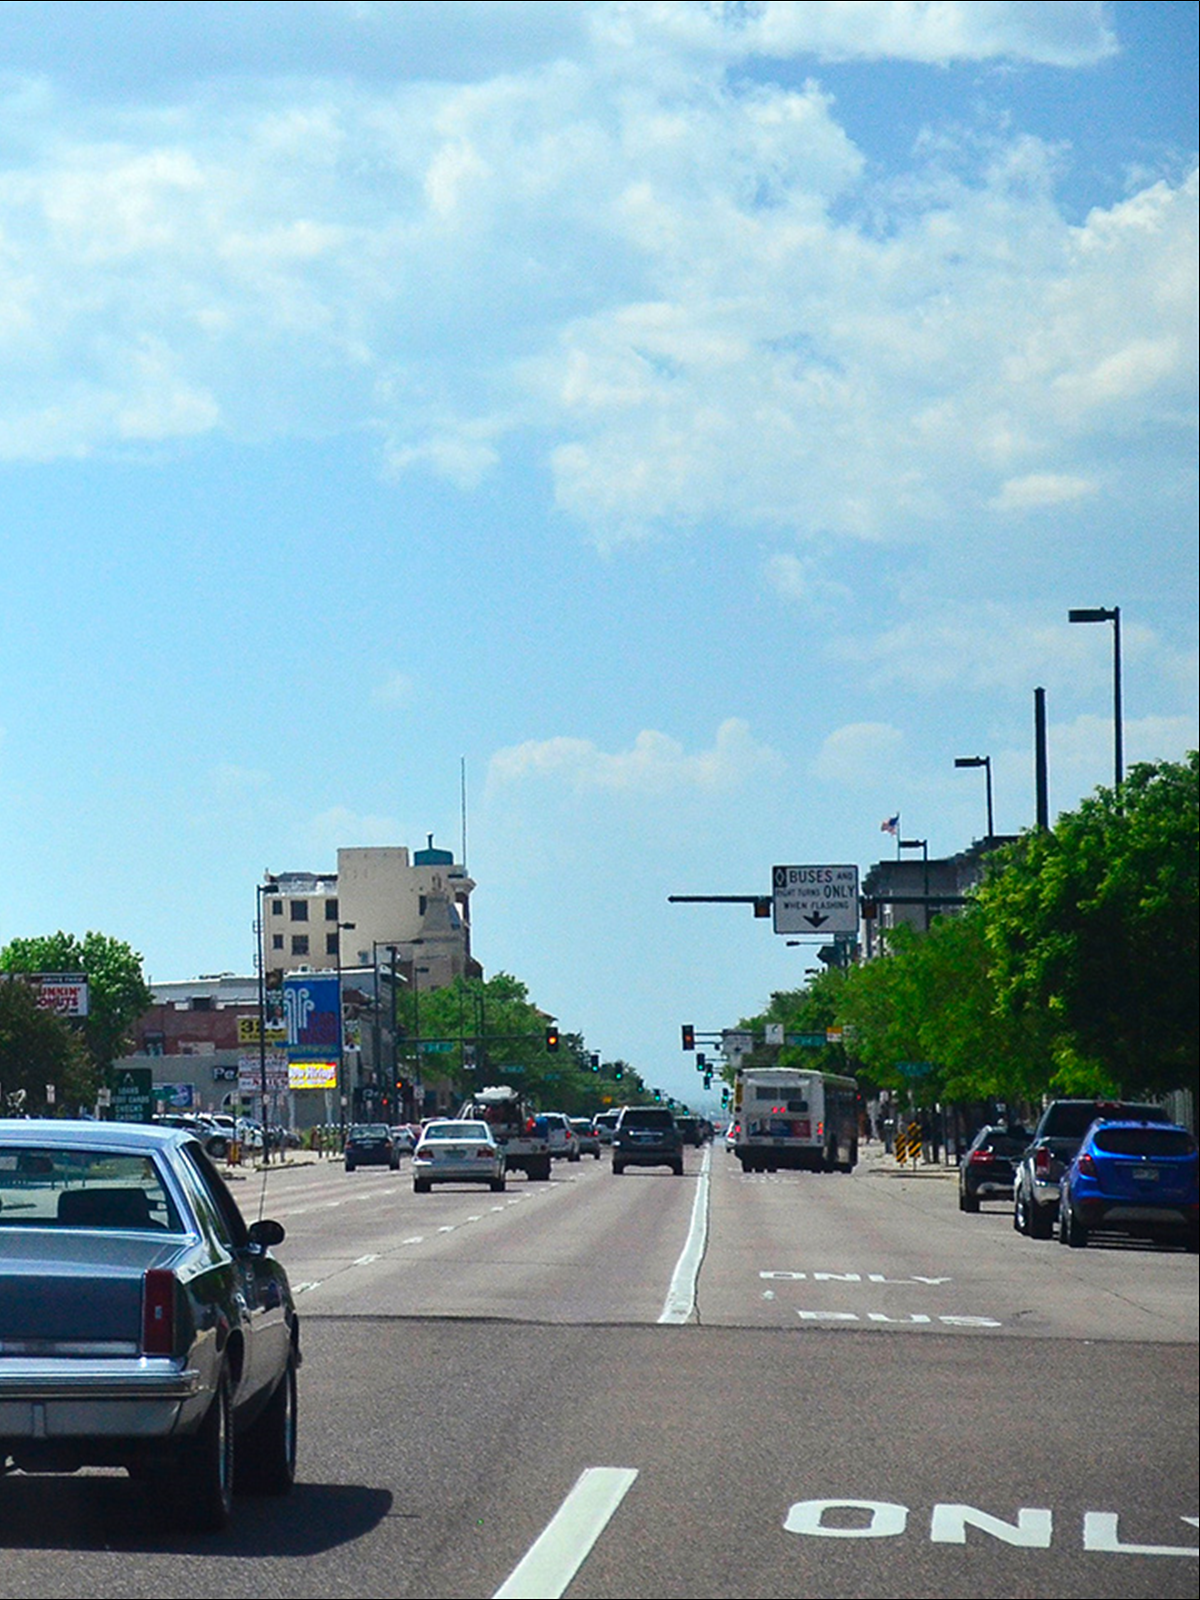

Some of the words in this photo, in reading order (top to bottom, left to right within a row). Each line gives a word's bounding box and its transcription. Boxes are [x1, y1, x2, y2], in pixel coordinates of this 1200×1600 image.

[789, 870, 833, 884] BUSES
[837, 872, 854, 880] AND
[823, 885, 855, 898] ONLY
[784, 902, 808, 910] WHEN
[811, 901, 849, 911] FLASHING
[759, 1271, 952, 1284] ONLY
[796, 1310, 1001, 1327] BUS
[783, 1500, 1198, 1556] ONL
